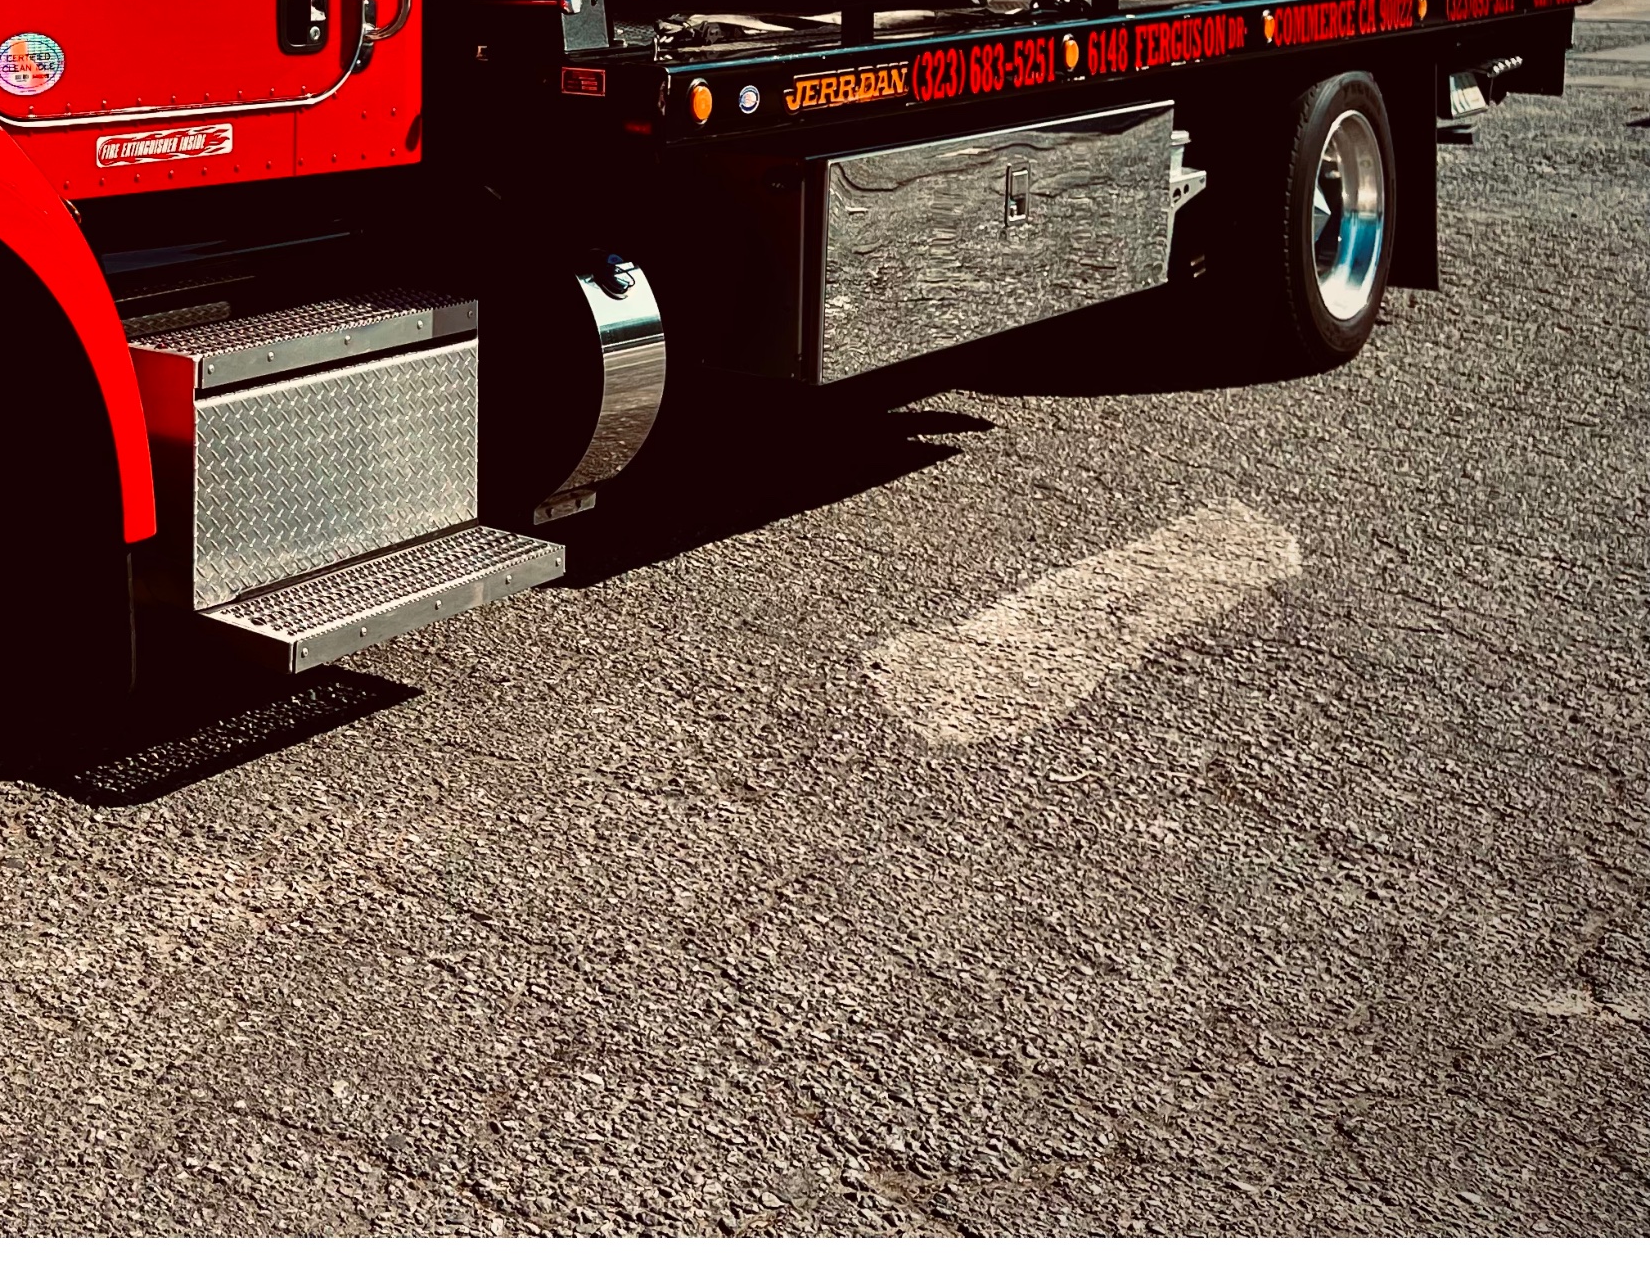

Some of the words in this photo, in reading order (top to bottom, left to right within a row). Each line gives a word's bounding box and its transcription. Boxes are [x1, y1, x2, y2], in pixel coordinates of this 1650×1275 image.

[1087, 27, 1129, 75] 6148
[1134, 14, 1227, 68] FERGUSON
[1274, 0, 1356, 47] COMMERCE
[101, 143, 120, 160] FIRE
[120, 137, 179, 158] EXTINGUISHER
[178, 133, 207, 152] INSIDE
